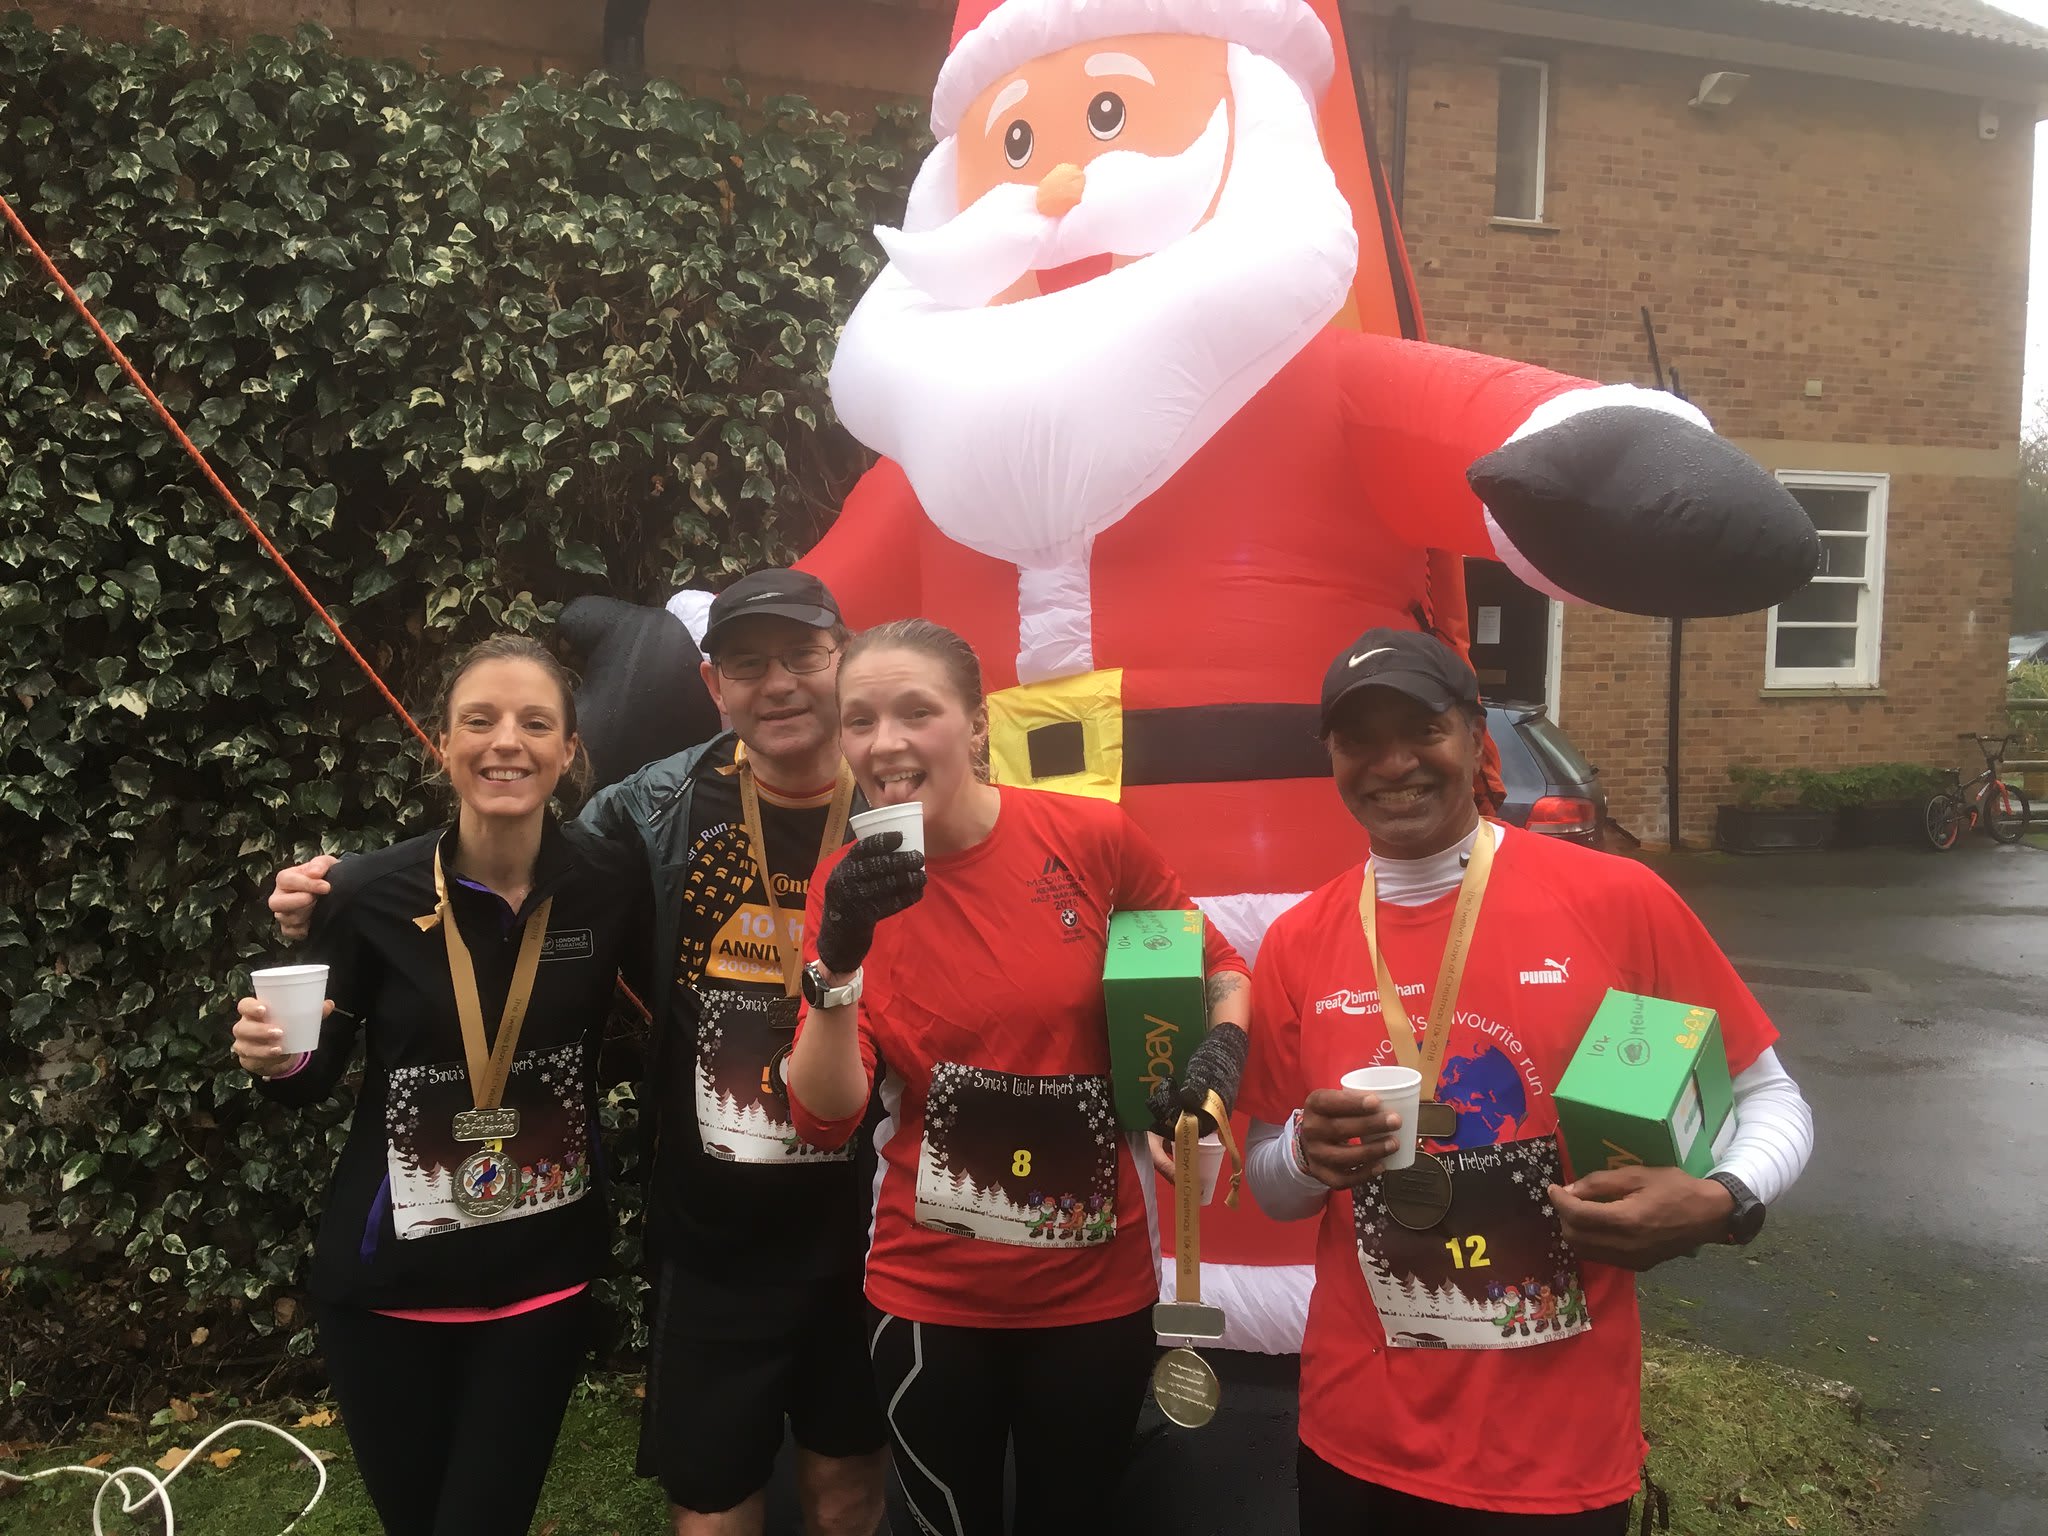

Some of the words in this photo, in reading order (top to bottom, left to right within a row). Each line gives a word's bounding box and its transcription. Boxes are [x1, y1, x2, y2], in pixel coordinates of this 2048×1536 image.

[700, 822, 729, 842] Run
[768, 872, 810, 896] Cont
[1054, 898, 1079, 911] 2018
[739, 911, 805, 942] 10h
[555, 936, 580, 944] LONDON
[1450, 938, 1463, 962] Days
[1519, 970, 1562, 985] PUMA
[736, 995, 768, 1012] Santa's
[1315, 995, 1342, 1015] great
[1350, 983, 1425, 1005] birmiham
[1138, 1013, 1180, 1094] bay
[1427, 1039, 1438, 1062] 2018
[428, 1065, 465, 1084] Santa's
[510, 1059, 534, 1076] lpers
[1518, 1057, 1544, 1096] run
[973, 1072, 1008, 1093] Santa's
[1012, 1076, 1035, 1097] Little
[1039, 1079, 1074, 1100] Helpers
[1011, 1150, 1032, 1177] 8
[1458, 1152, 1502, 1173] Helpers
[944, 1226, 977, 1239] running
[1445, 1234, 1491, 1270] 12
[1415, 1340, 1448, 1350] running
